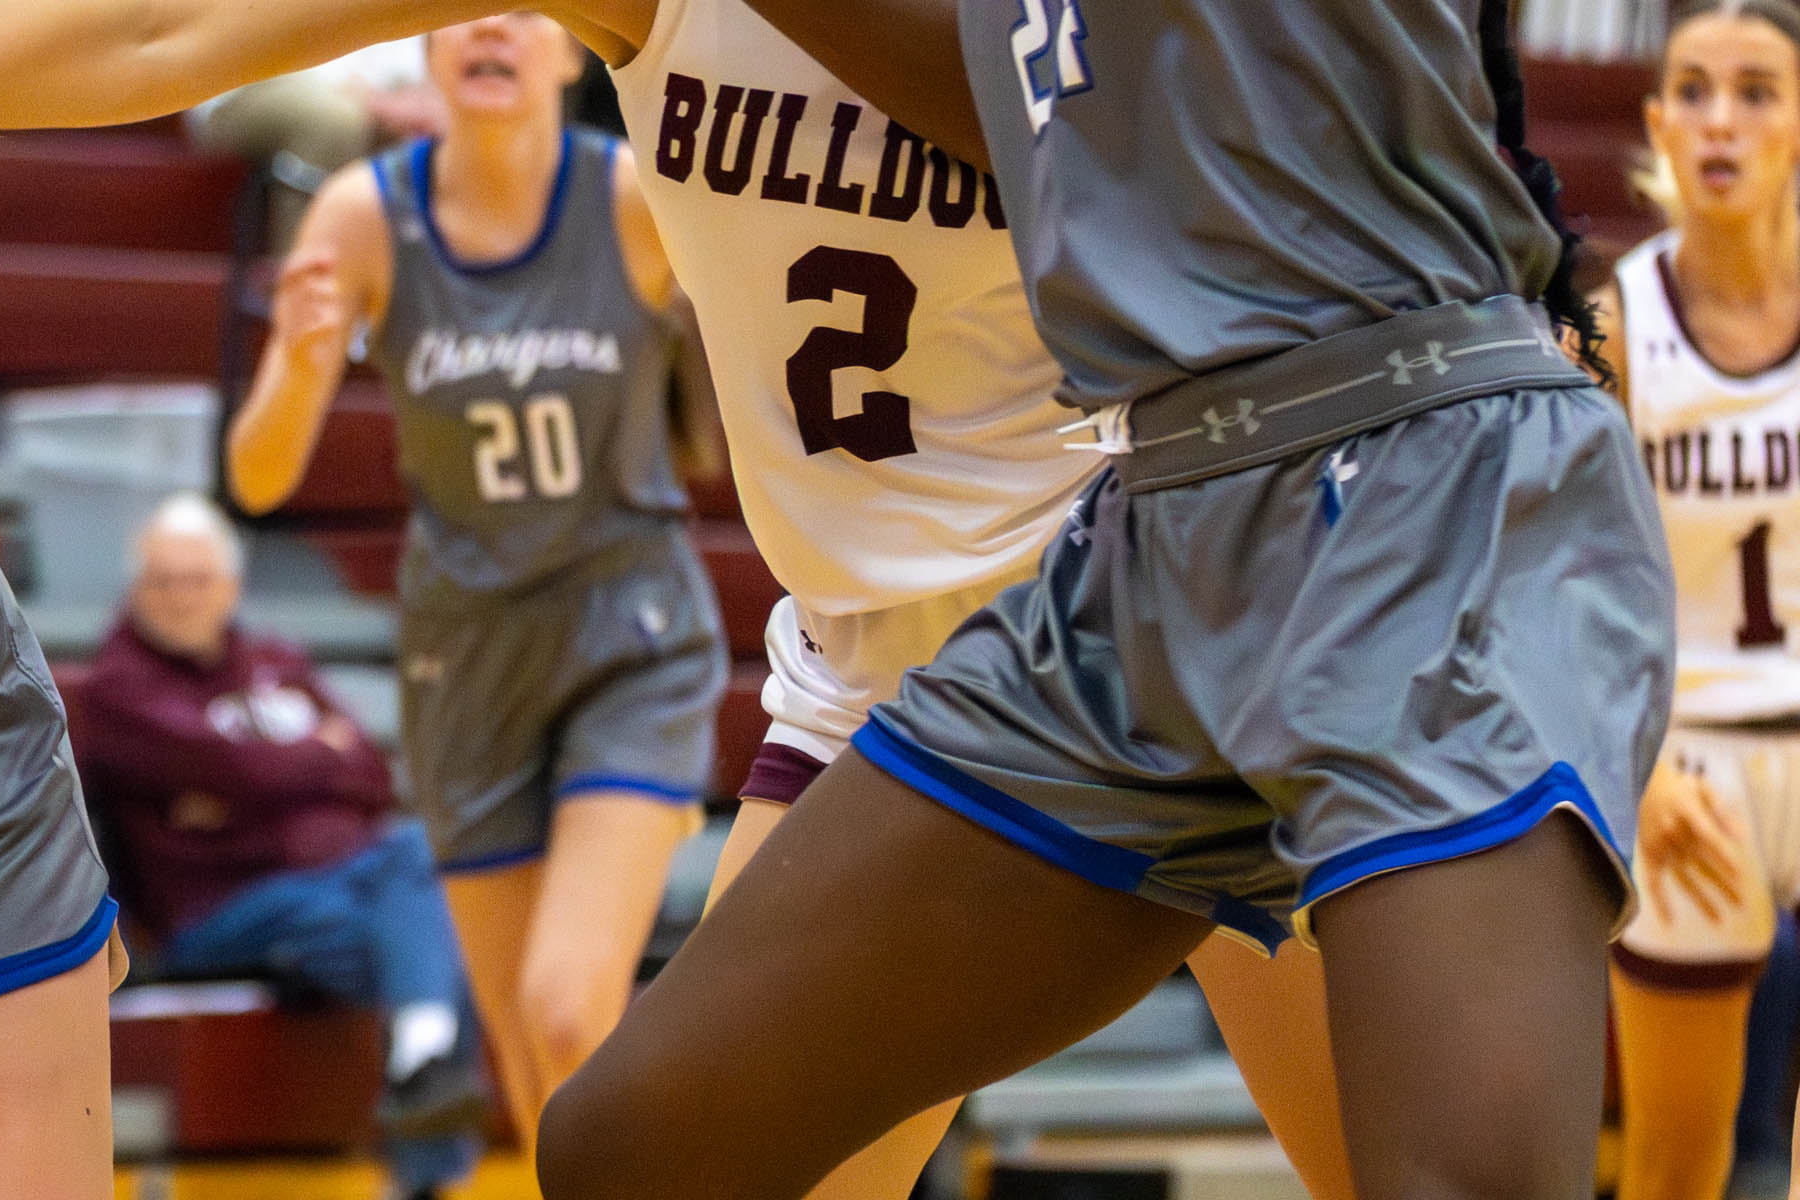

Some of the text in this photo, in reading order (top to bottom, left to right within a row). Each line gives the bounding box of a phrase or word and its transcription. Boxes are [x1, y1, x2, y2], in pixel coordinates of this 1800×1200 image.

[786, 245, 918, 462] 2
[463, 392, 584, 501] 20
[1642, 428, 1800, 493] ULLD
[1735, 519, 1786, 649] 1
